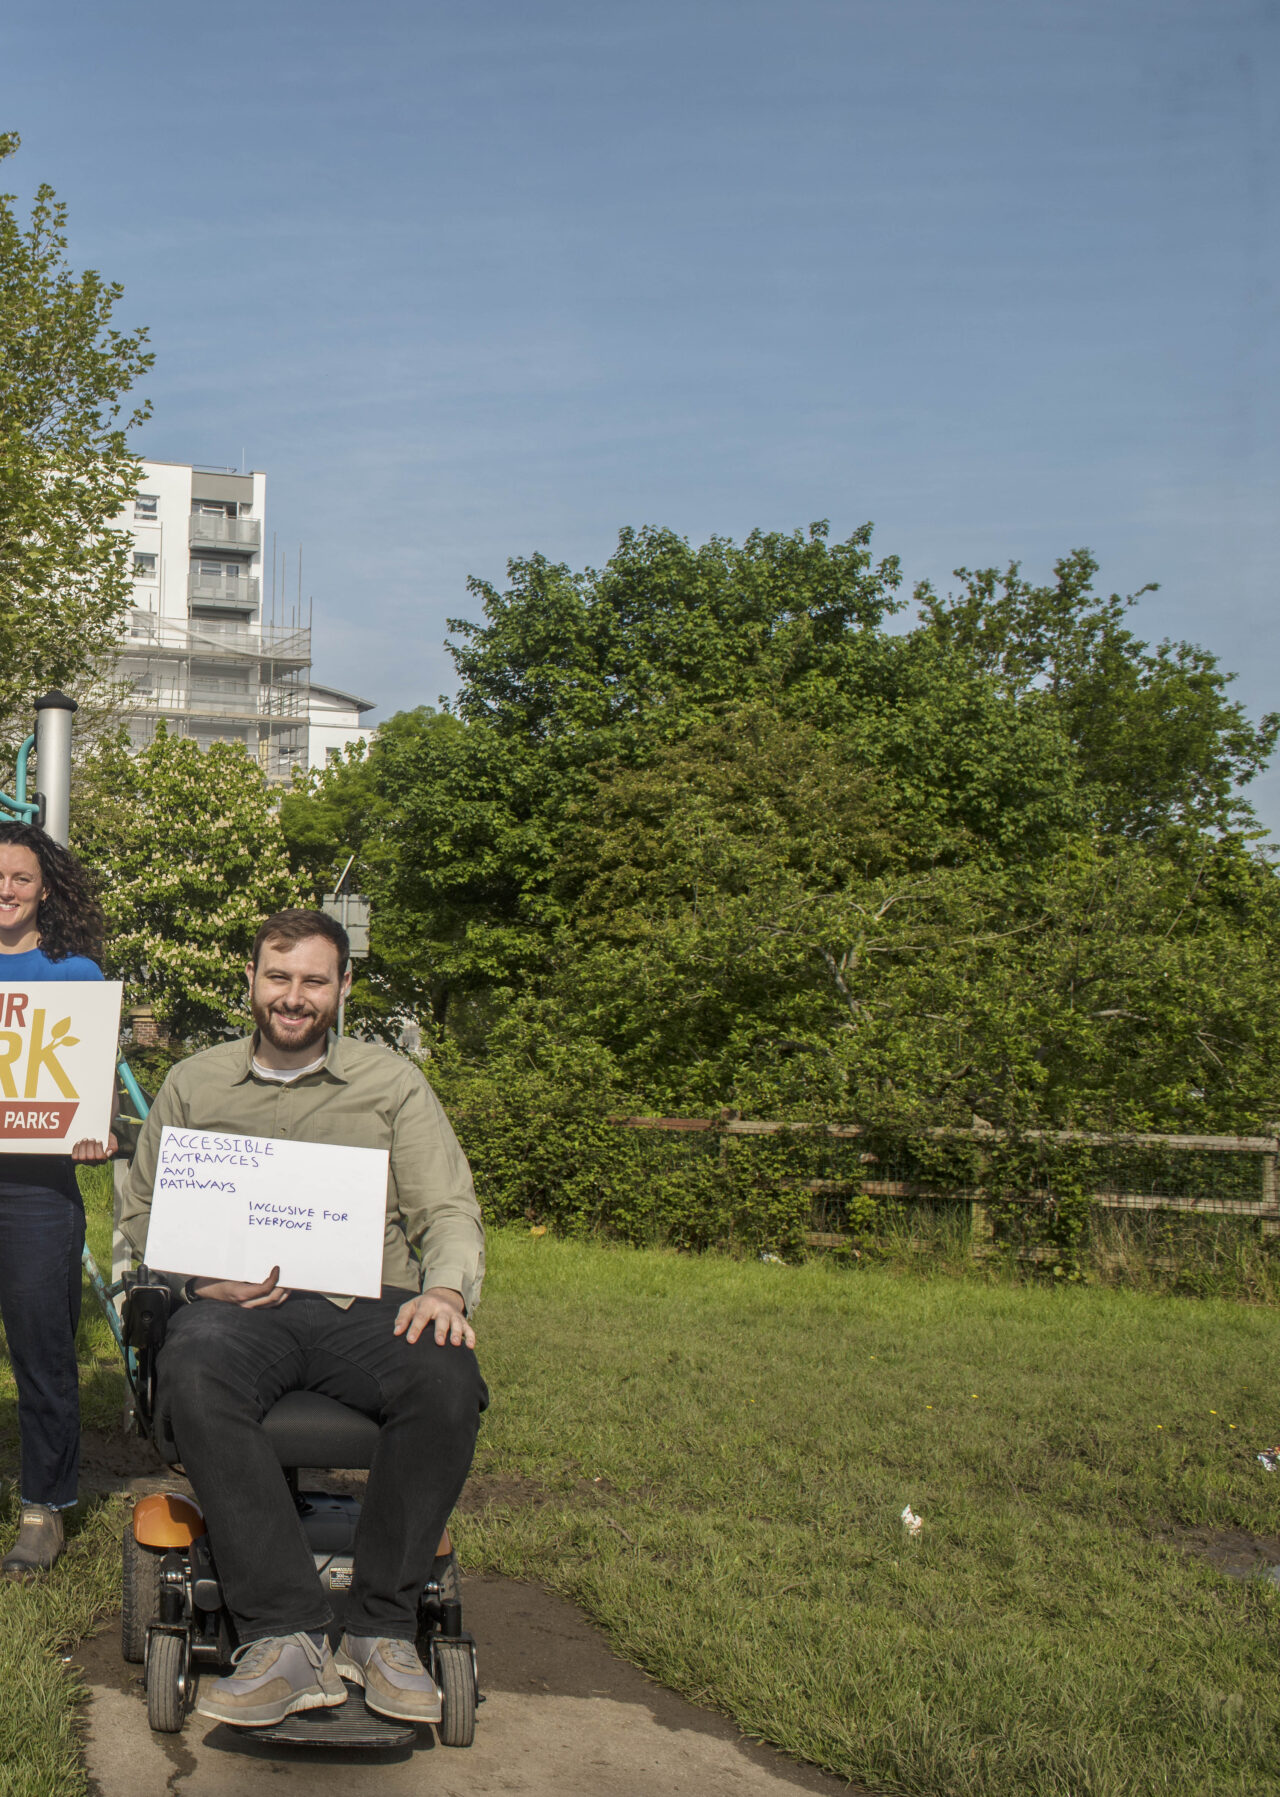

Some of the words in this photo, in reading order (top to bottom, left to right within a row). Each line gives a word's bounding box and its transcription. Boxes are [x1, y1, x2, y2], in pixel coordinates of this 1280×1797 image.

[3, 1111, 60, 1130] PARKS
[165, 1133, 274, 1155] ACCESSIBLE
[162, 1151, 259, 1167] ENTRANCES
[163, 1167, 195, 1177] AND
[160, 1178, 236, 1193] PATHWAYS
[249, 1201, 315, 1216] INCLUSIVE
[323, 1210, 348, 1221] FOR
[248, 1215, 312, 1230] EVERYONE
